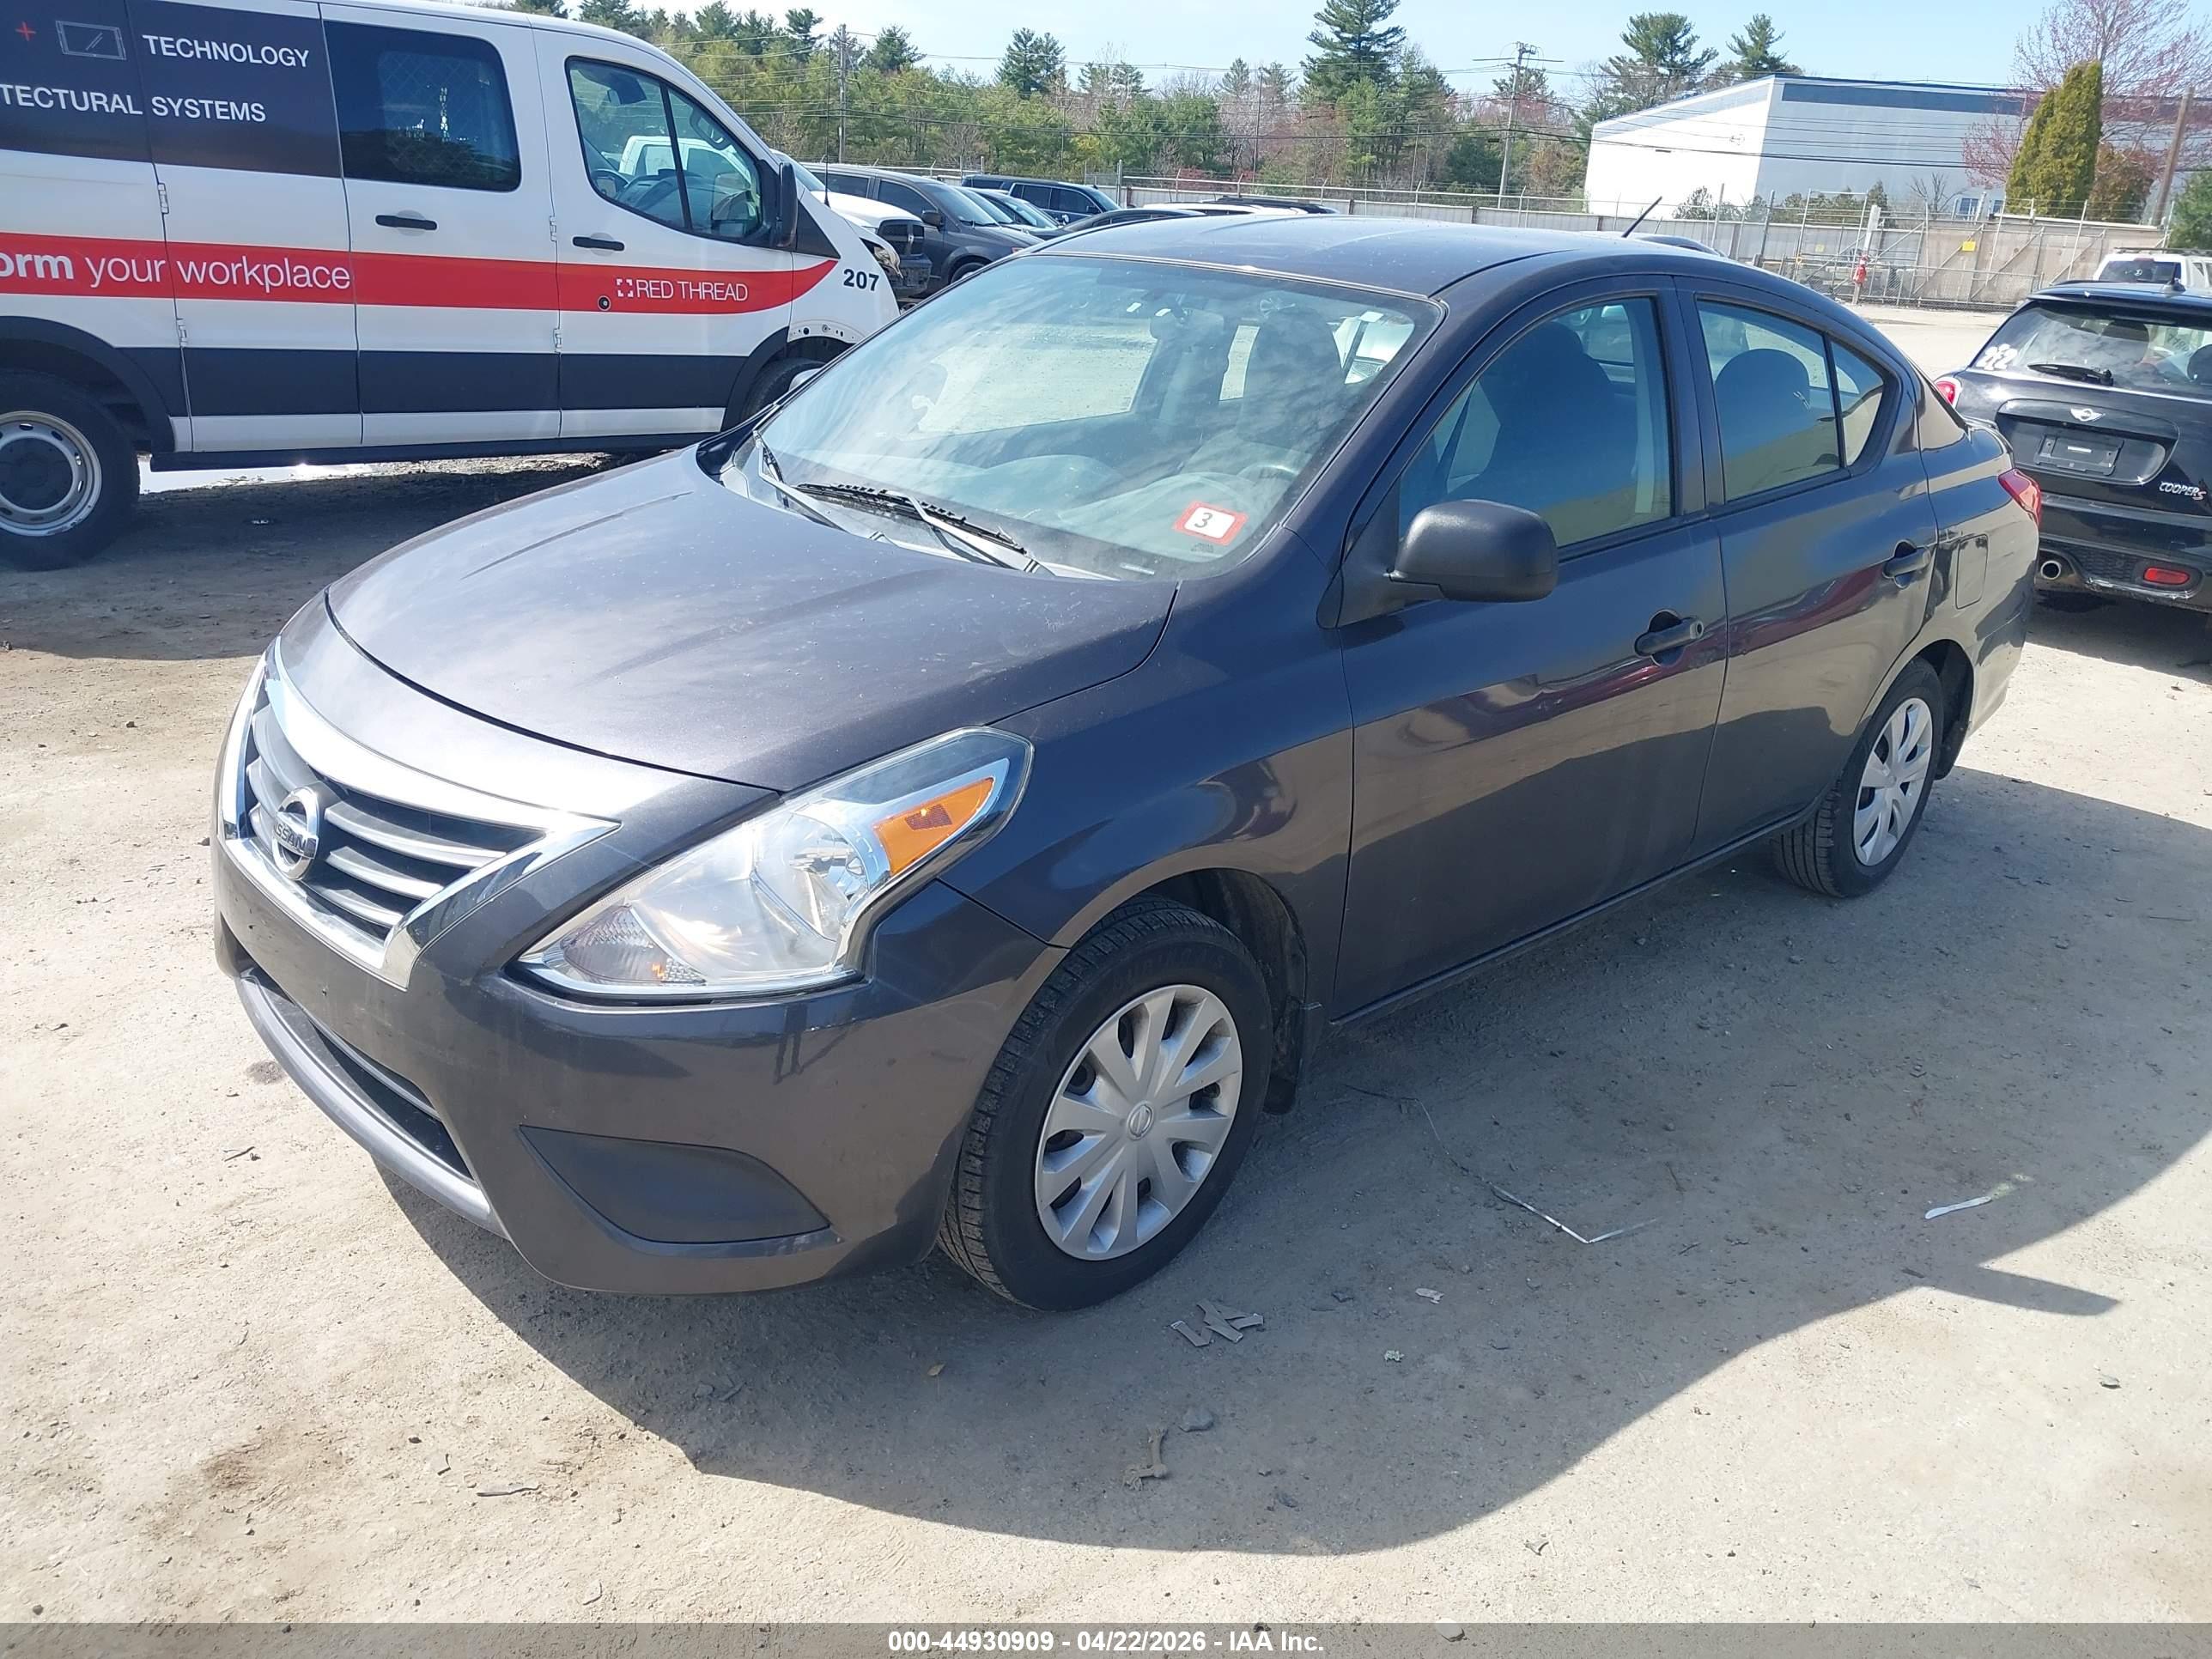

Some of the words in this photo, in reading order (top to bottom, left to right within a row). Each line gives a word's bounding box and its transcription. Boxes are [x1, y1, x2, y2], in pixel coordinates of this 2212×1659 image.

[143, 34, 309, 67] TECHNOLOGY
[0, 84, 143, 114] TECTURAL
[152, 96, 266, 122] SYSTEMS
[85, 257, 165, 288] your
[176, 256, 350, 293] workplace
[843, 268, 879, 292] 207
[636, 279, 674, 299] RED
[678, 281, 748, 301] THREAD
[2159, 481, 2200, 496] COOPER
[1194, 512, 1213, 528] 3
